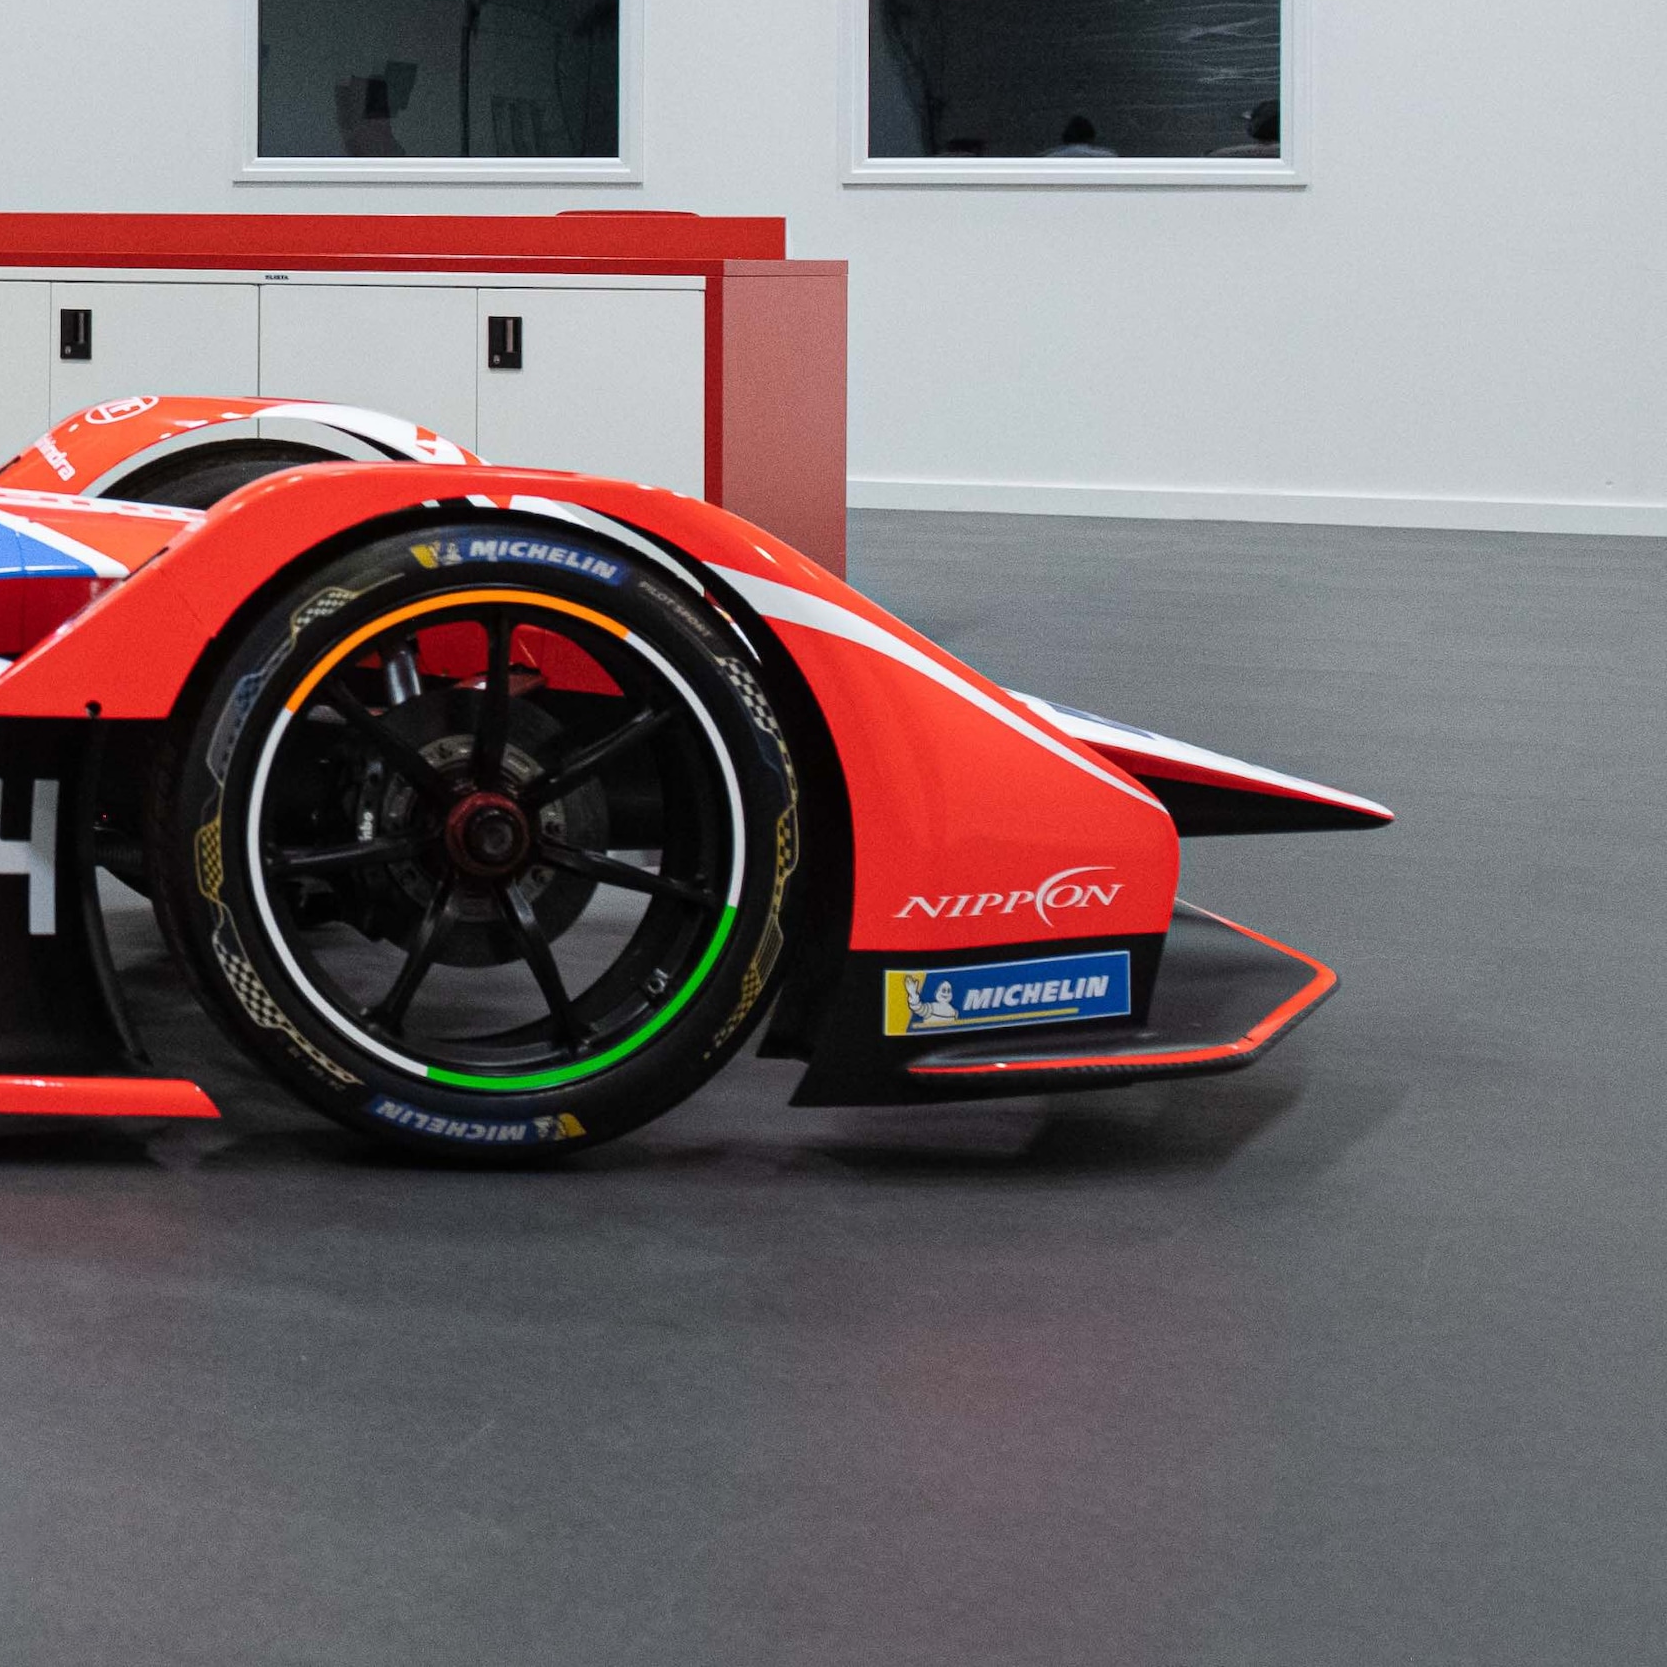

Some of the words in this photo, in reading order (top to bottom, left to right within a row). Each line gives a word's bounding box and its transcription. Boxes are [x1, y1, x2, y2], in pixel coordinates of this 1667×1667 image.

[468, 538, 620, 580] MICHELIN
[893, 873, 1125, 923] NIPPON
[962, 974, 1110, 1011] MICHELIN
[373, 1098, 527, 1142] MICHELIN
